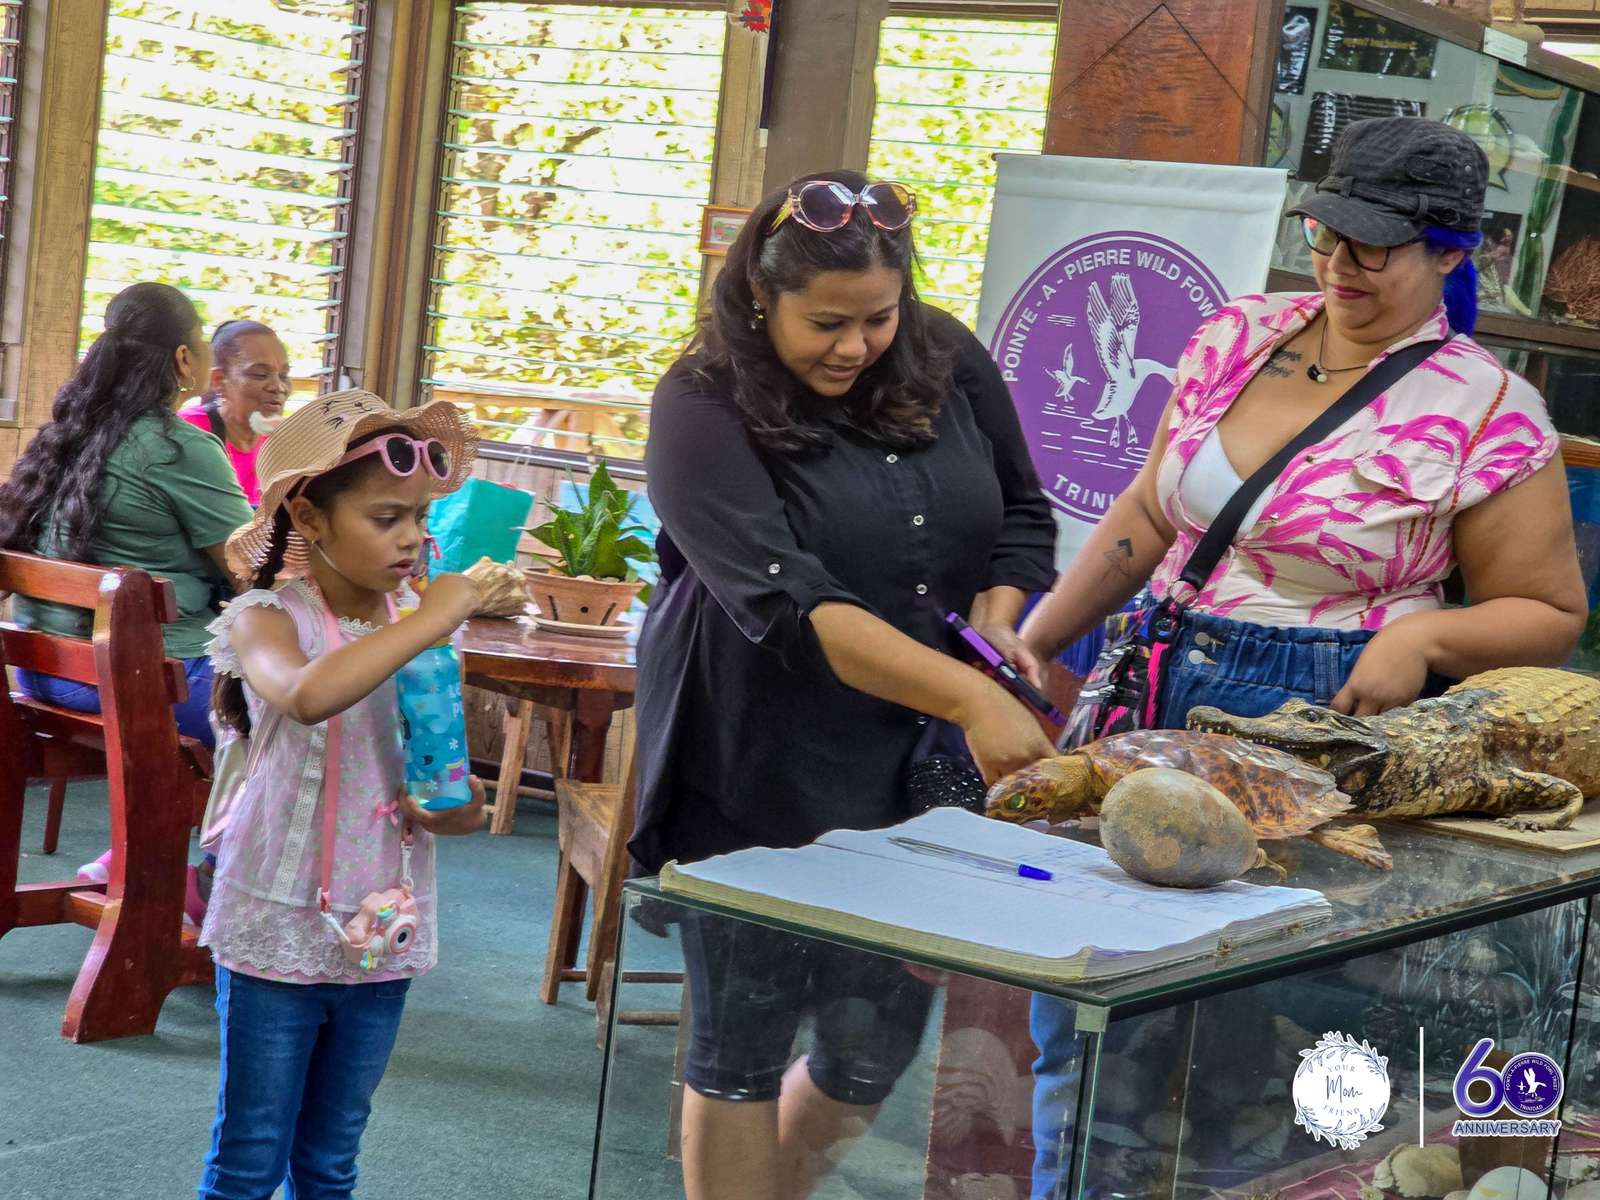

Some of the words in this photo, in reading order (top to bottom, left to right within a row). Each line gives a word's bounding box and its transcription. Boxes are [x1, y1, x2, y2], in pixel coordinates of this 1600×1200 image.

[1002, 307, 1038, 382] POINTE
[1041, 284, 1056, 301] A
[1064, 249, 1131, 280] PIERRE
[1136, 250, 1181, 281] WILD
[1180, 275, 1217, 317] FOW
